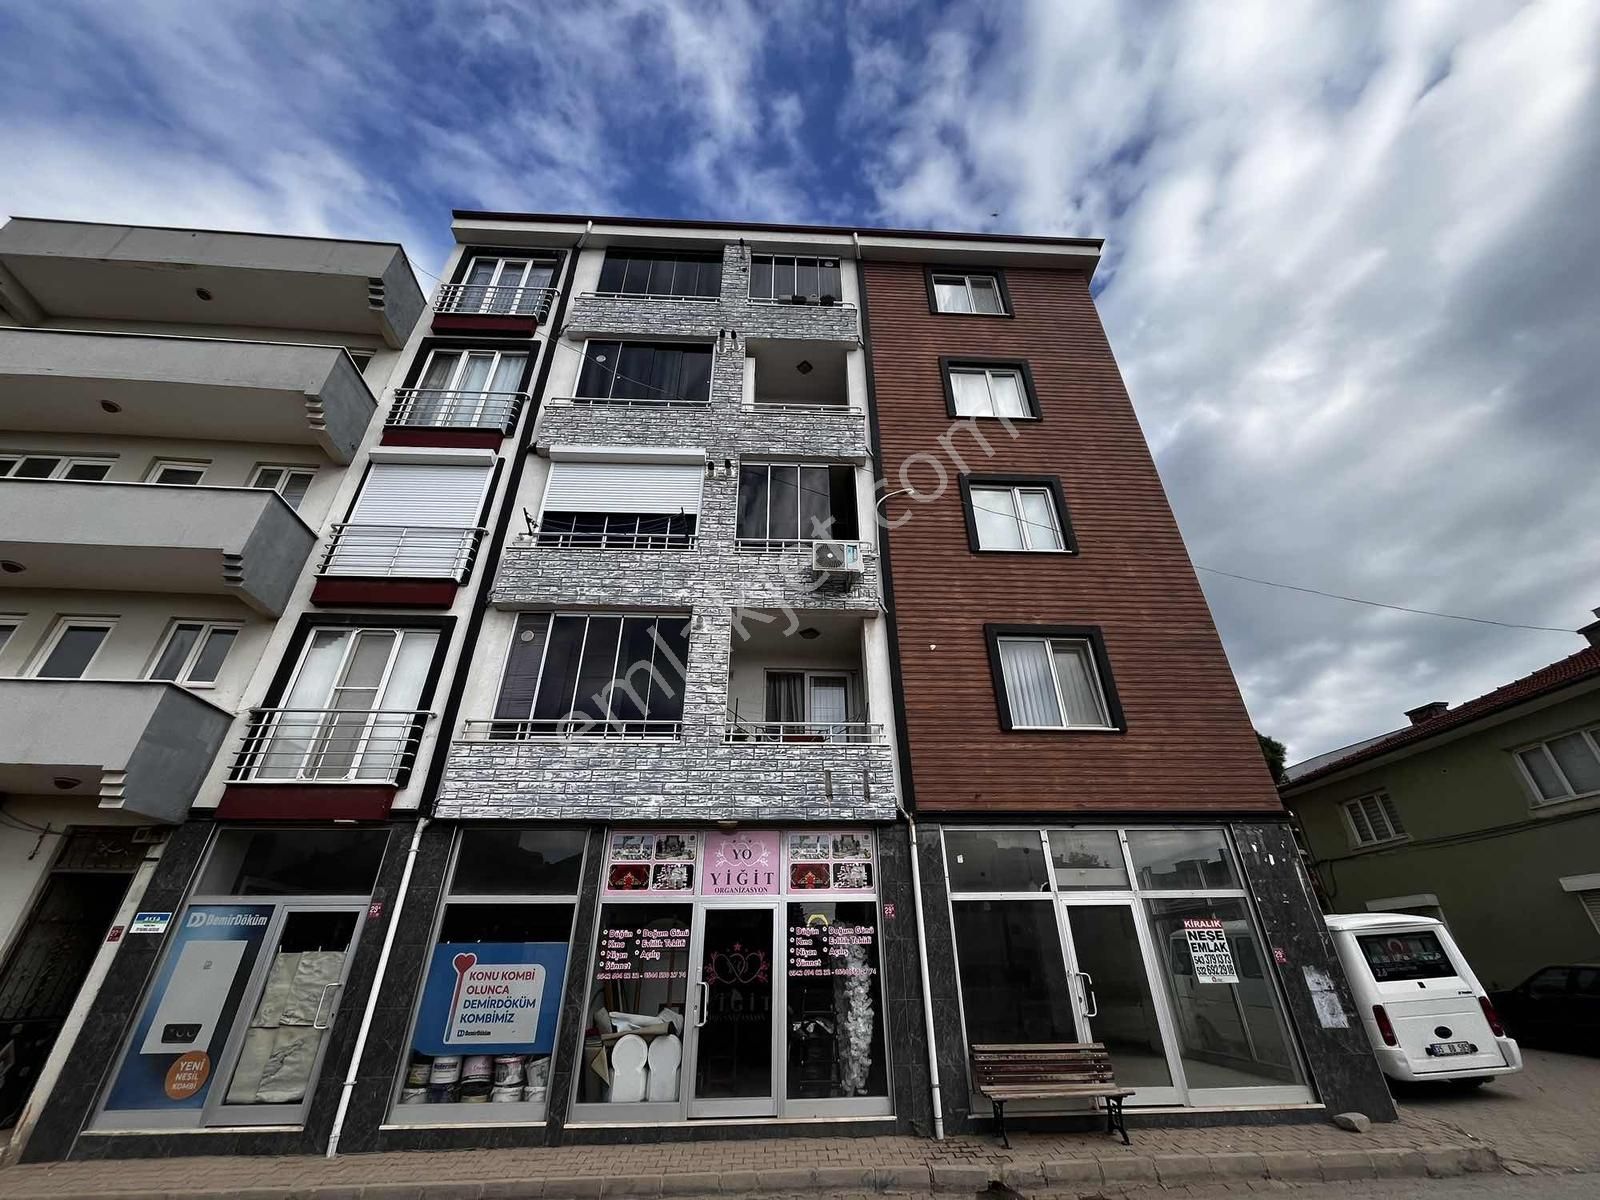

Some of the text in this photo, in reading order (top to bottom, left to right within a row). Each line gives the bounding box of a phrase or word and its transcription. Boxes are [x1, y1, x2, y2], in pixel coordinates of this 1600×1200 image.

[710, 869, 774, 886] YİĞİT
[1184, 919, 1222, 928] KİRALIK
[642, 929, 669, 939] Doğum
[1187, 930, 1225, 942] NEŞE
[1190, 942, 1229, 952] EMLAK
[470, 968, 536, 981] KONU KOMBİ
[466, 985, 510, 995] OLUNCA
[463, 996, 536, 1008] DEMİRDÖKÜM
[460, 1010, 515, 1024] KOMBİMİZ
[180, 1058, 206, 1071] YENİ
